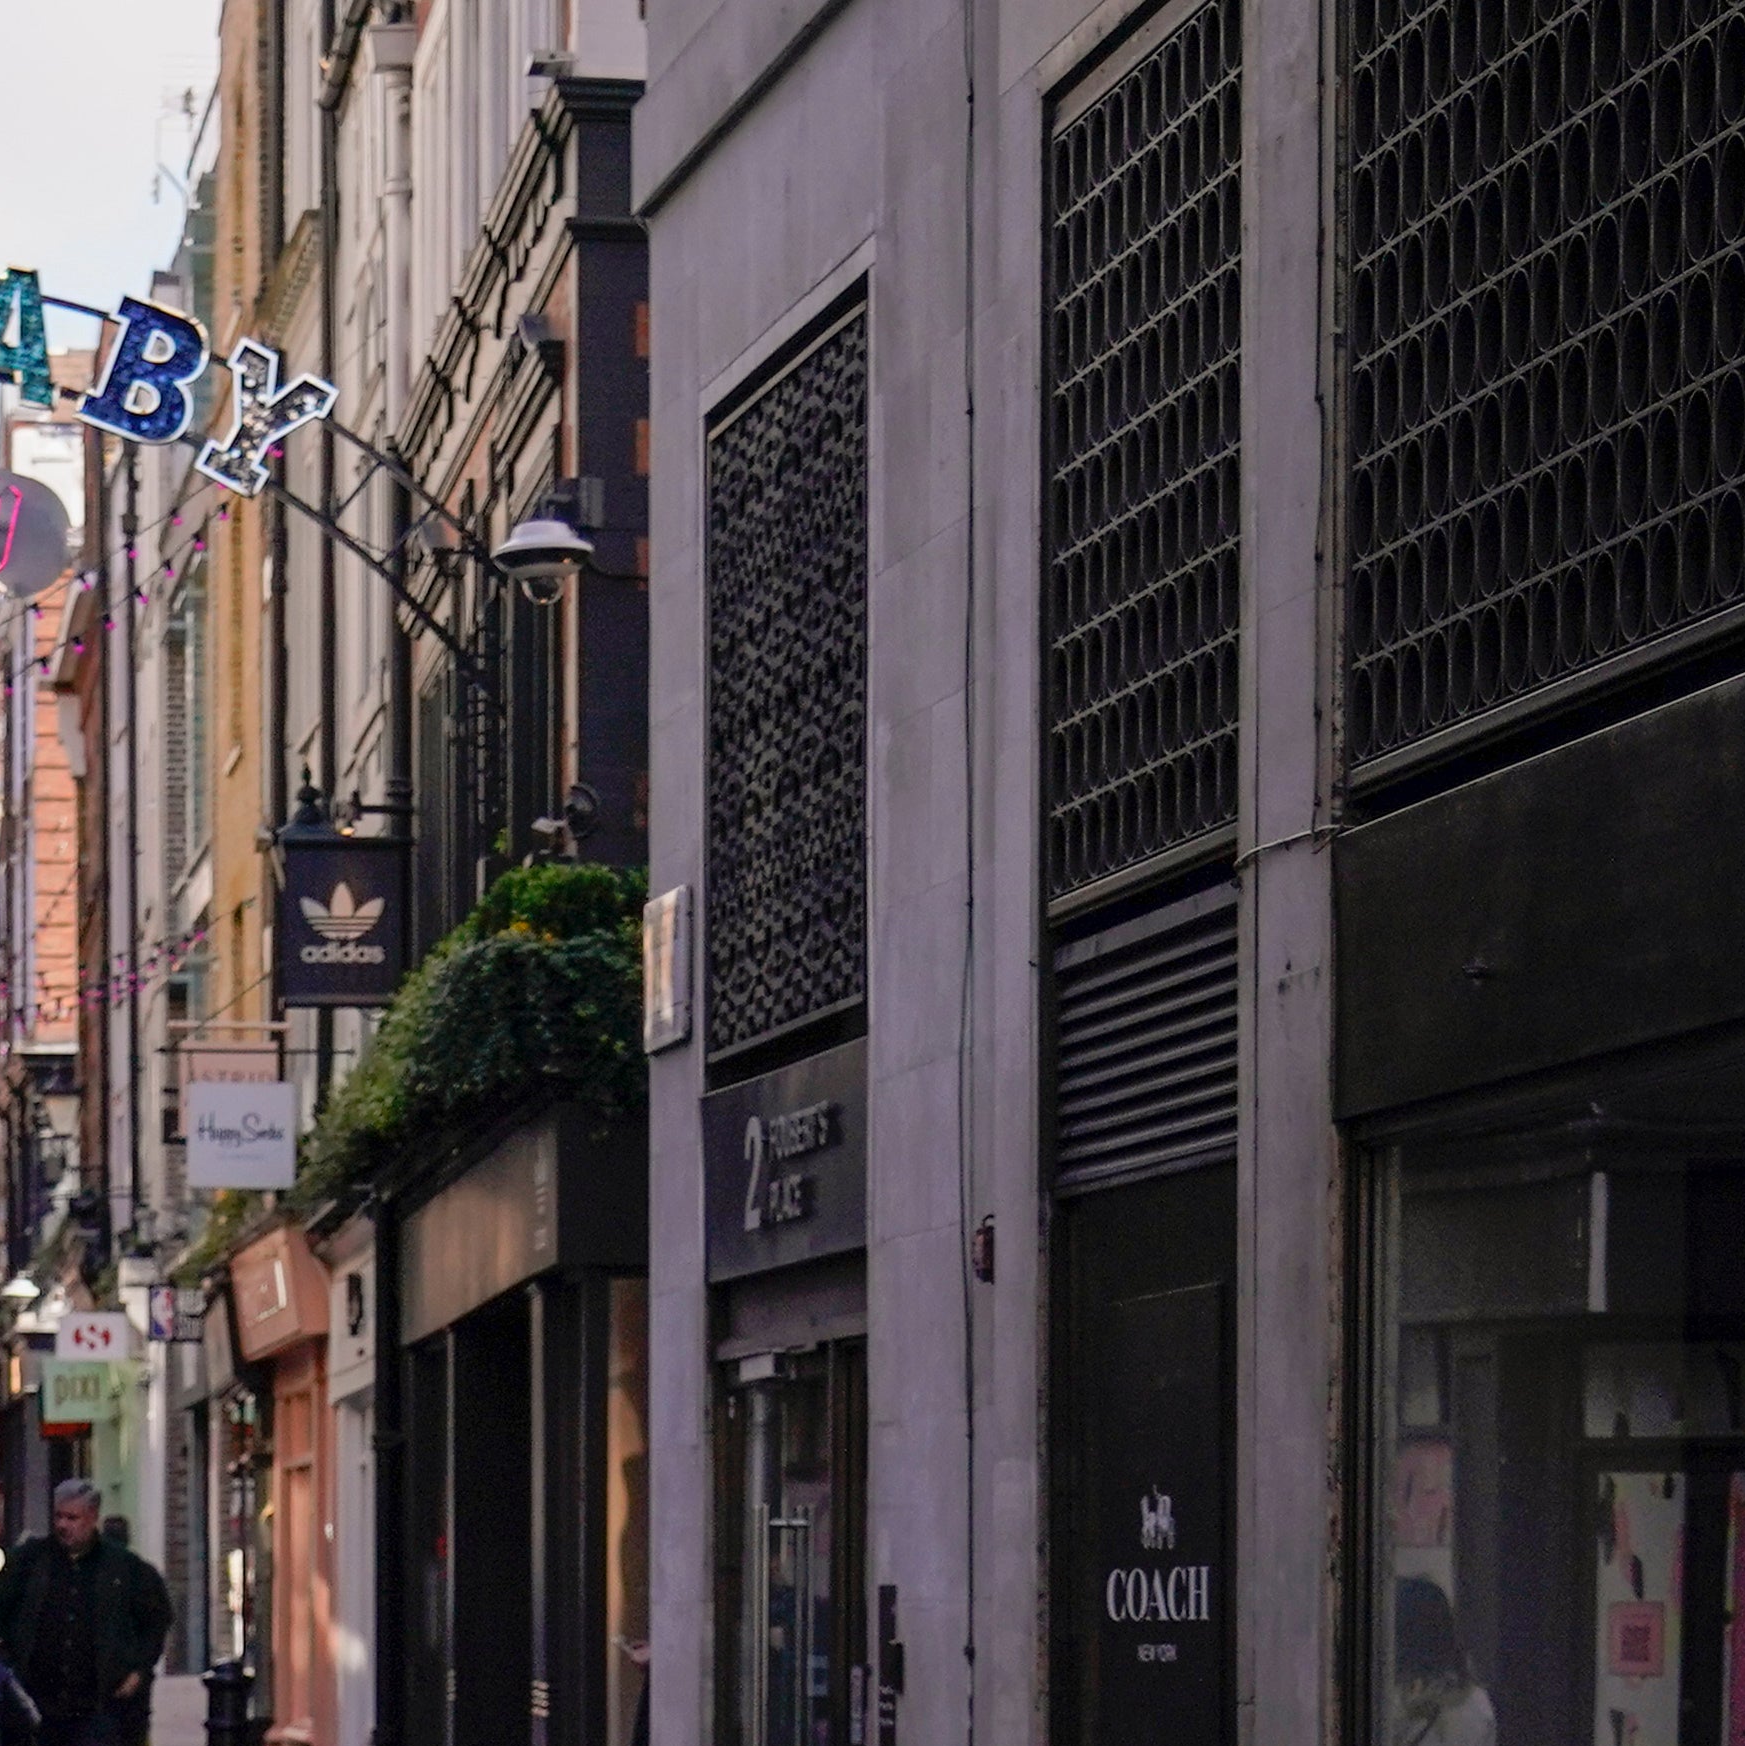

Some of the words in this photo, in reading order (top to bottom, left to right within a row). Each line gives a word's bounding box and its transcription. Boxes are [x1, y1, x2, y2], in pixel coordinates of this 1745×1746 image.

[300, 941, 386, 965] adidas
[744, 1116, 763, 1232] 2
[1106, 1566, 1210, 1621] COACH
